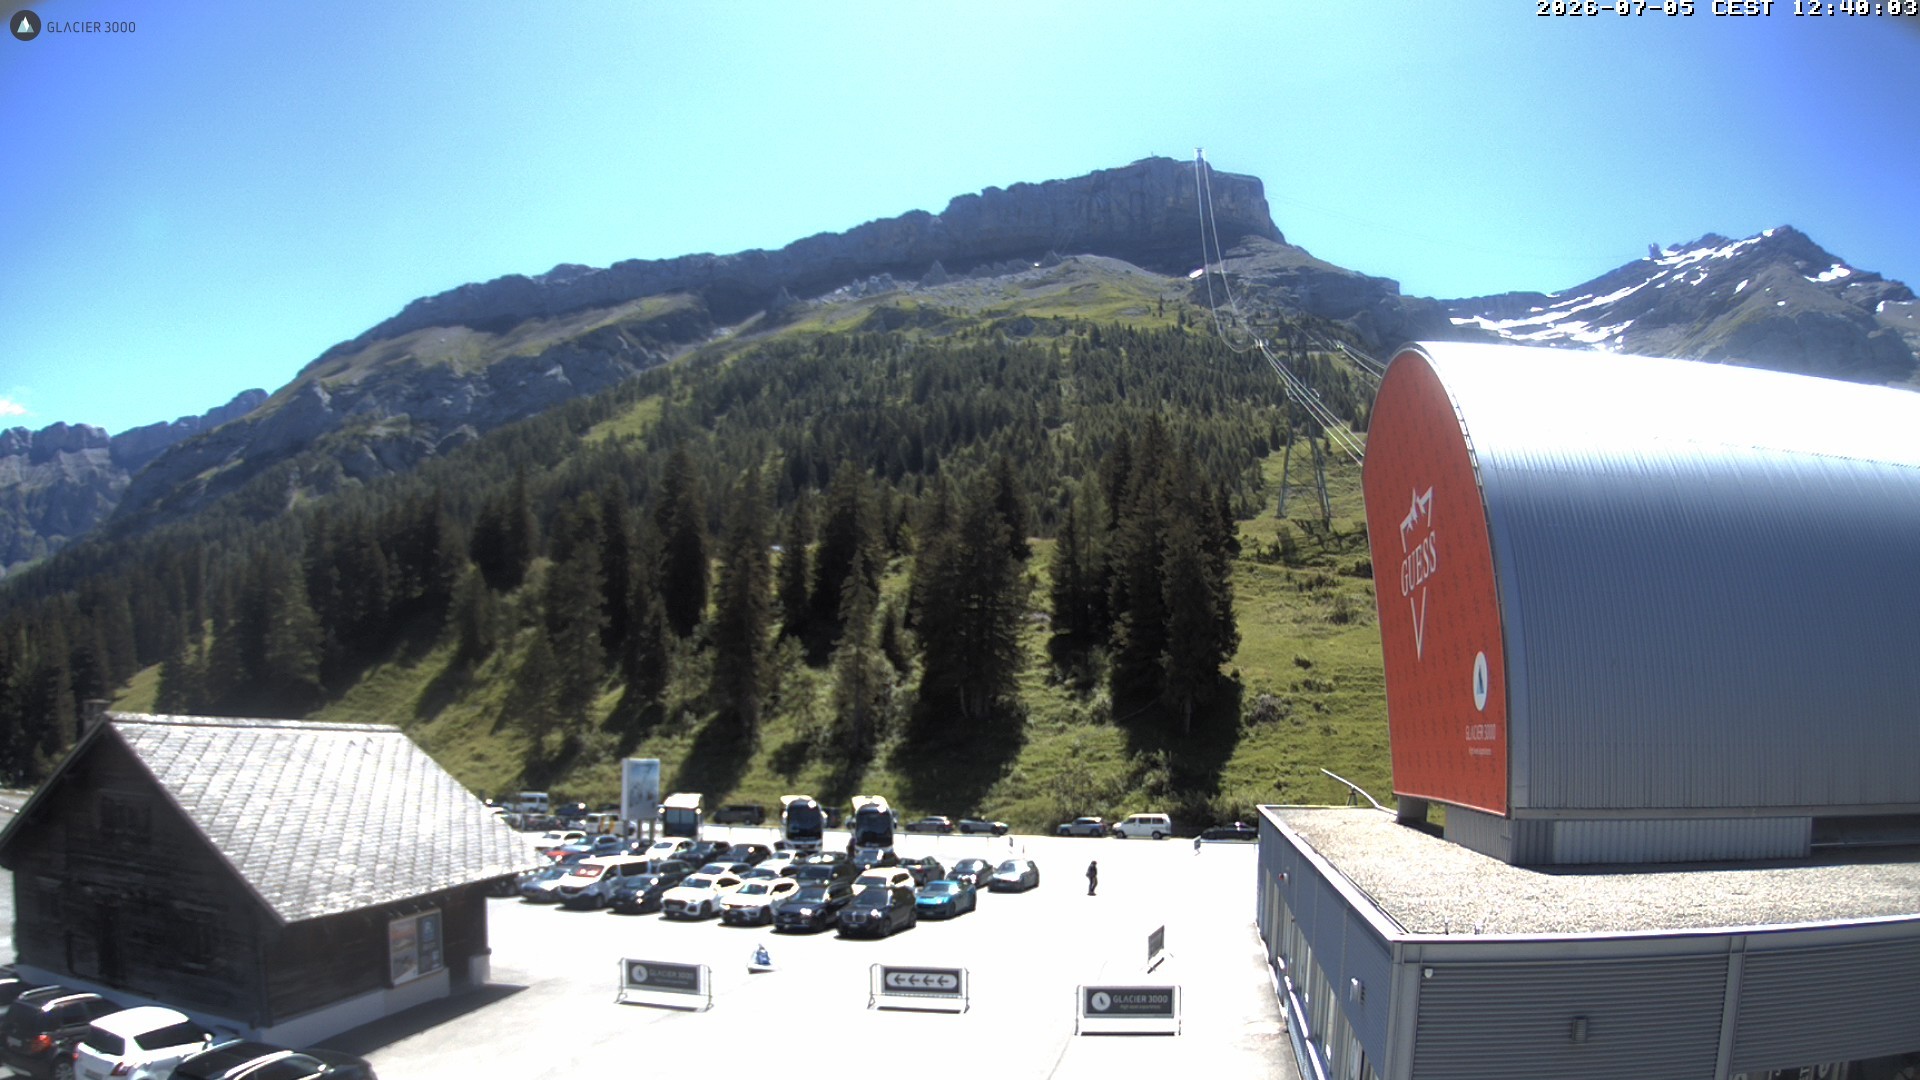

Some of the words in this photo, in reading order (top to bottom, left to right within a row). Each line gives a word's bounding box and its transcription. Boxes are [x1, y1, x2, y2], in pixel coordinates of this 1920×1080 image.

[1401, 530, 1437, 597] GUESS
[1112, 994, 1147, 1004] GLACIER
[1148, 994, 1169, 1004] 3000
